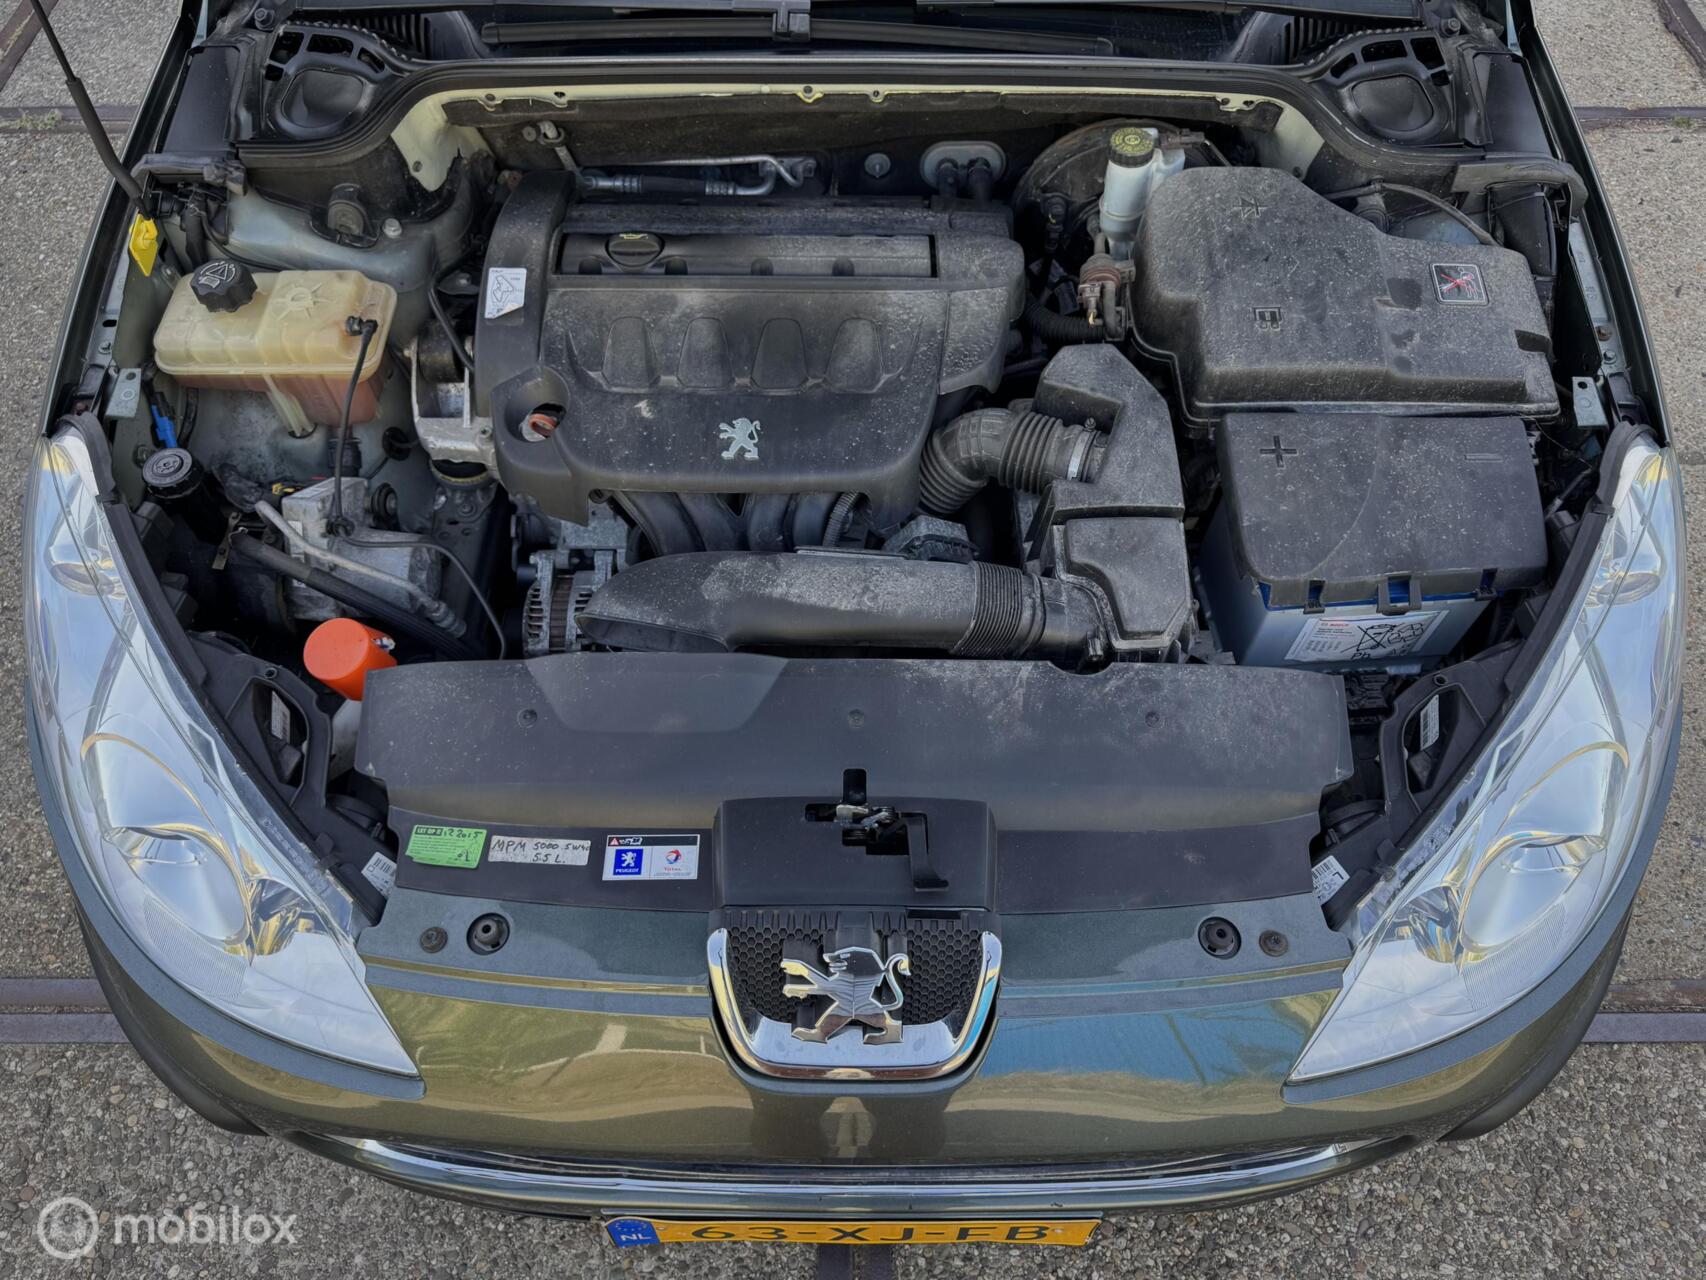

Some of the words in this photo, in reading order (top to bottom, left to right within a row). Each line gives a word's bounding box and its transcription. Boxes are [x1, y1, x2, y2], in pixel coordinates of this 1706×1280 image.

[1351, 652, 1371, 660] Pb
[492, 840, 526, 854] MPM
[532, 842, 559, 851] 5000
[620, 1233, 651, 1241] NL
[691, 1226, 1051, 1241] 63-XJ-FB
